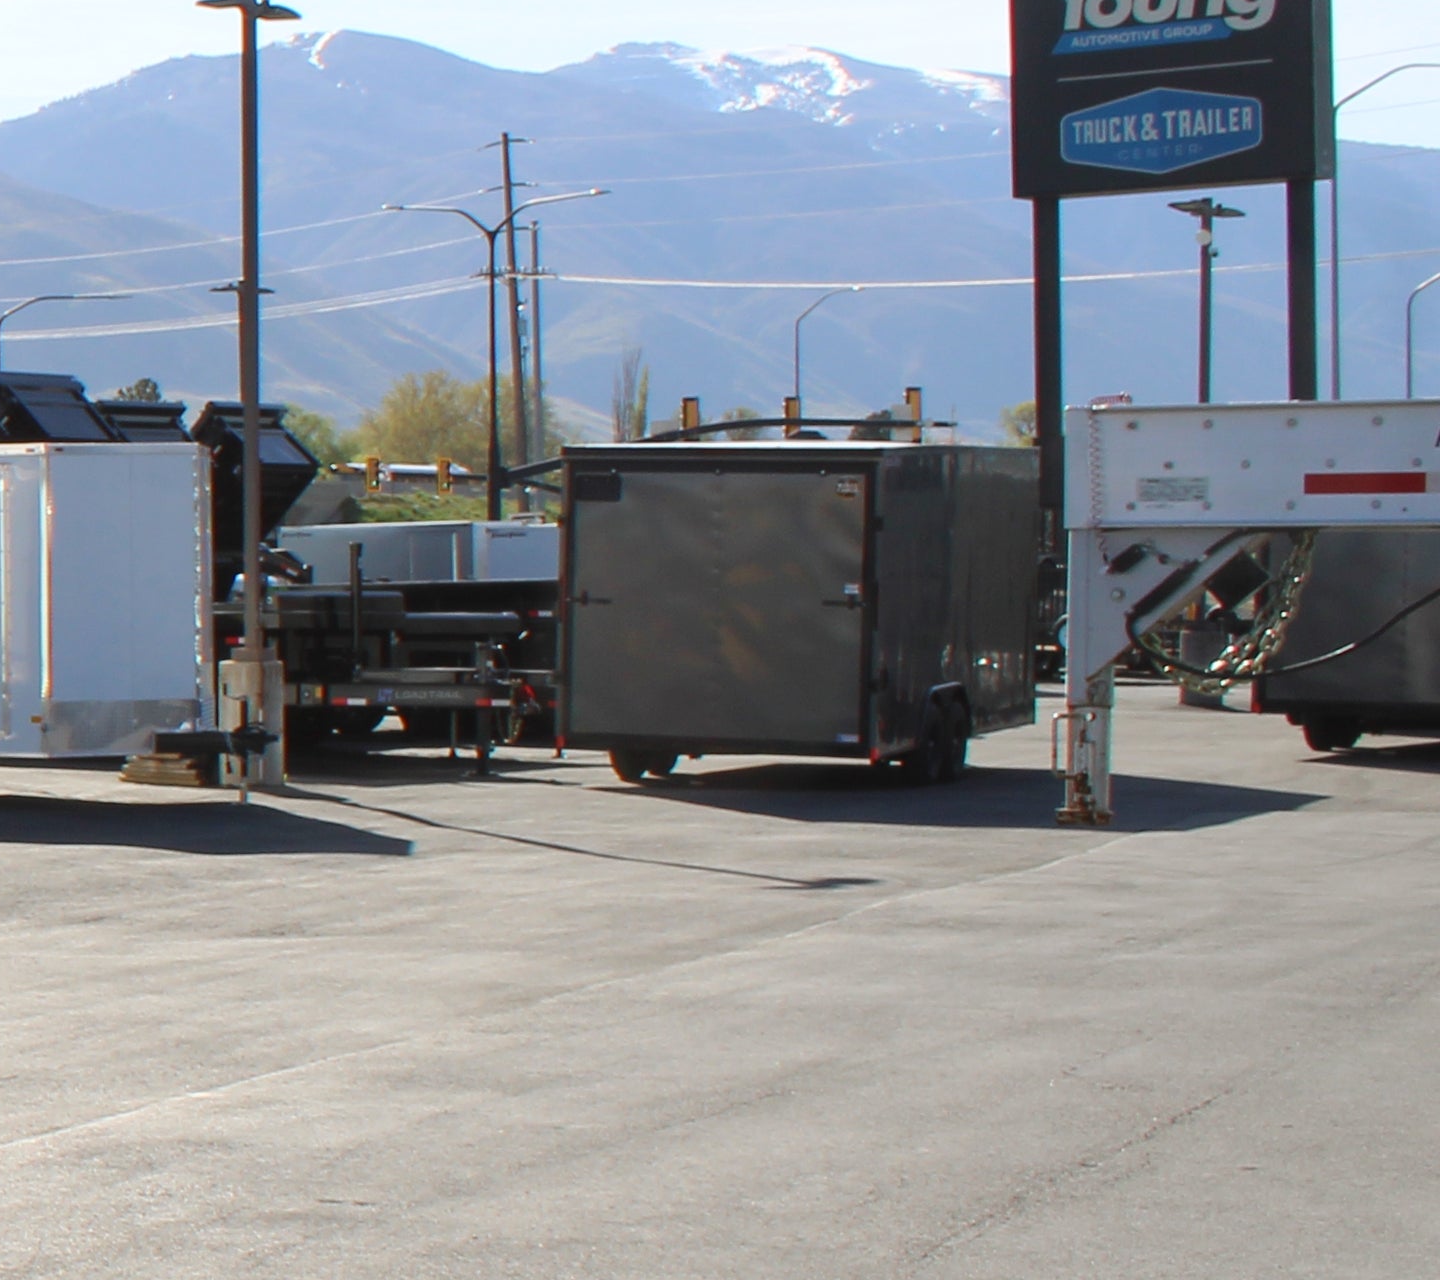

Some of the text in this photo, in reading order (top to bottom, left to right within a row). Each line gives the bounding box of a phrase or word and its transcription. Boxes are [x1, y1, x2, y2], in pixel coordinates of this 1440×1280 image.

[1070, 23, 1213, 47] AUTOMOTIVE GROUP
[1073, 106, 1253, 145] TRUCK & TRAILER
[1118, 143, 1199, 160] CENTER
